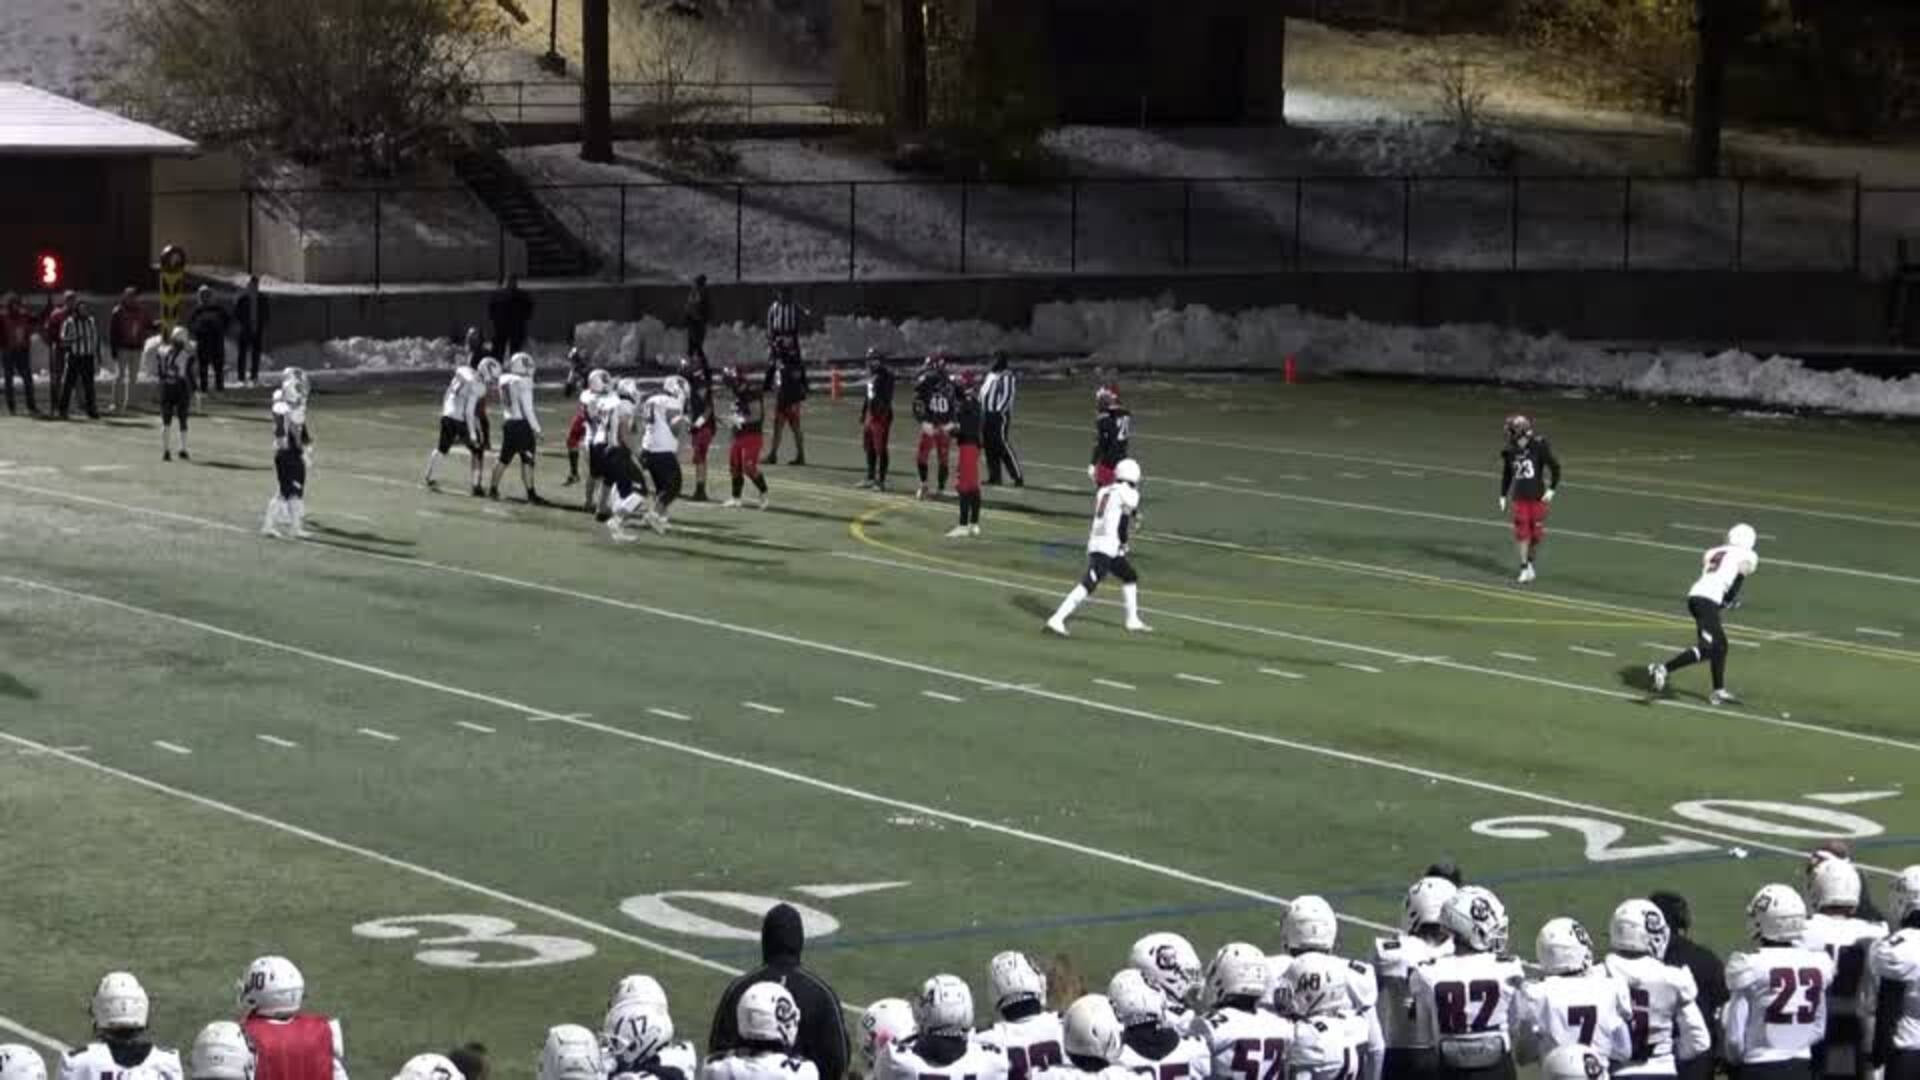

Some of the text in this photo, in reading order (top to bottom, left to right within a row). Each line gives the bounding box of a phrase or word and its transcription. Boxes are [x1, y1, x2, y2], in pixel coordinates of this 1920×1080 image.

[43, 256, 57, 283] 3
[1513, 458, 1535, 480] 23
[1470, 798, 1887, 863] 20
[351, 888, 841, 969] 30
[1433, 978, 1501, 1034] 82
[1763, 967, 1823, 1025] 23
[1567, 1004, 1597, 1047] 7
[1230, 1038, 1285, 1080] 52
